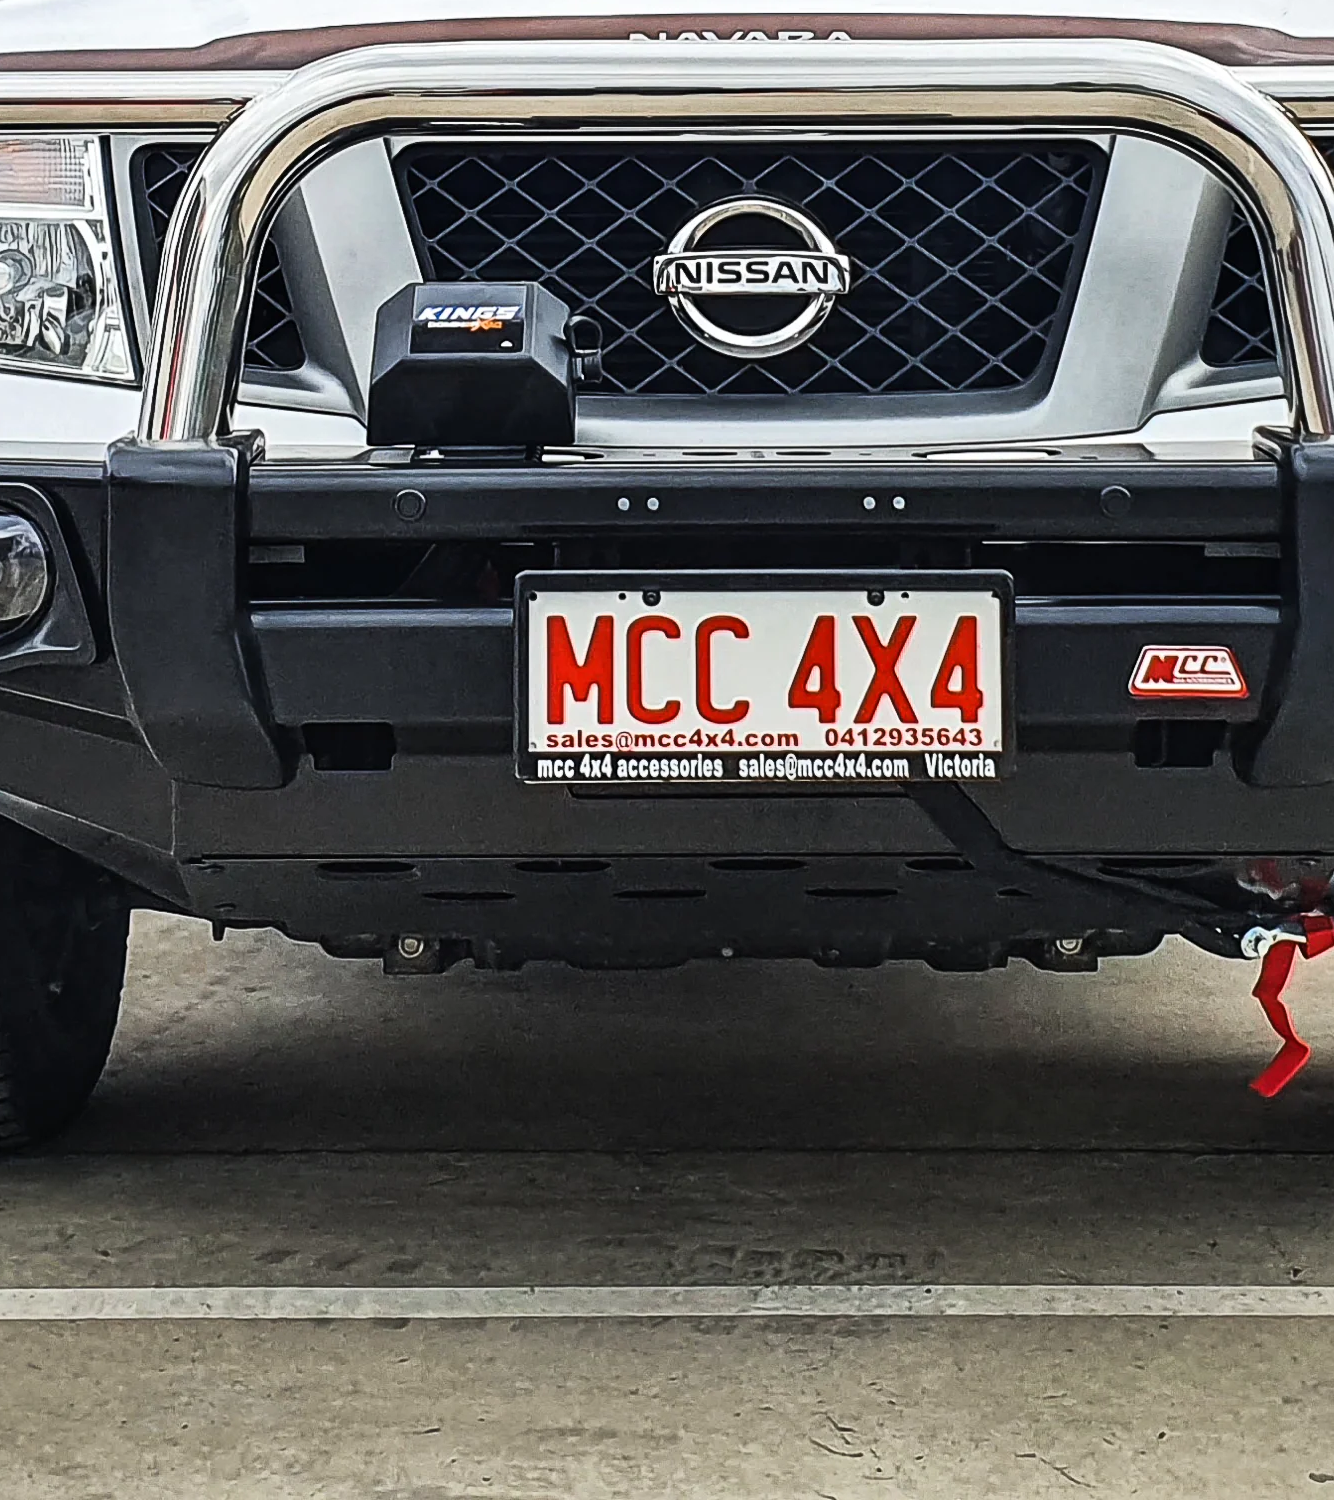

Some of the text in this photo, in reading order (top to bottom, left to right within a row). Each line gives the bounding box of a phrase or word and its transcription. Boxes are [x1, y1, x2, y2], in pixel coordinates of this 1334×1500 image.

[675, 261, 829, 284] NISSAN
[417, 306, 521, 320] KINGS
[546, 615, 984, 725] MCC 4X4
[1141, 655, 1232, 684] MCC
[546, 727, 983, 752] sales@mcc4x4.com 0412935643
[537, 753, 996, 780] mcc 4x4 accessories sales@mcc4x4.com Victoria
